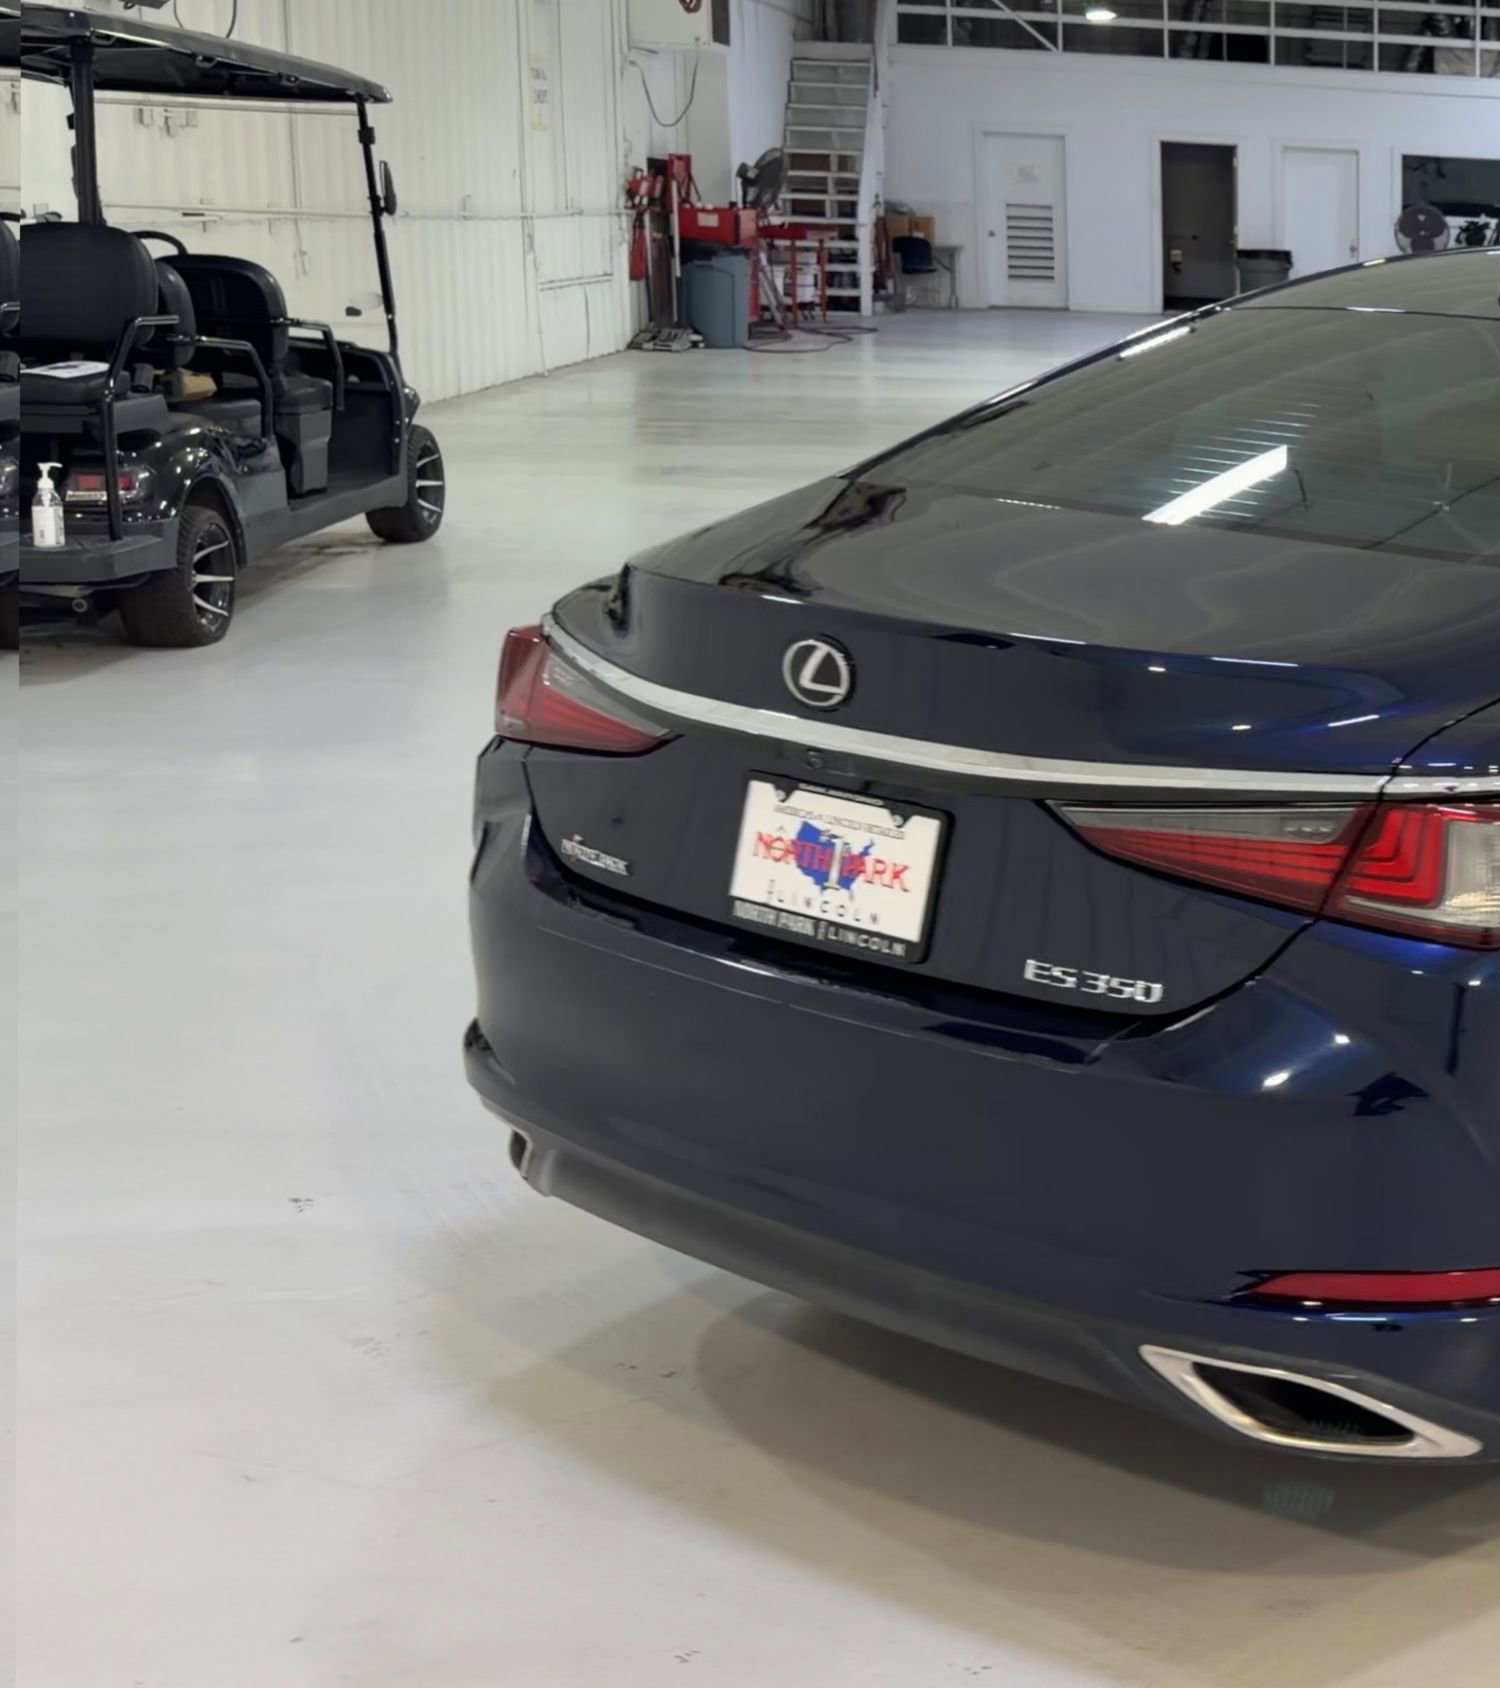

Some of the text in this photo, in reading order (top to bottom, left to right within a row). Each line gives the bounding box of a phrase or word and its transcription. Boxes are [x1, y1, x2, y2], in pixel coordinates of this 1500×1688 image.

[752, 831, 830, 873] NORTH
[827, 925, 907, 957] LINCOLN
[1024, 959, 1163, 1003] ES 350
